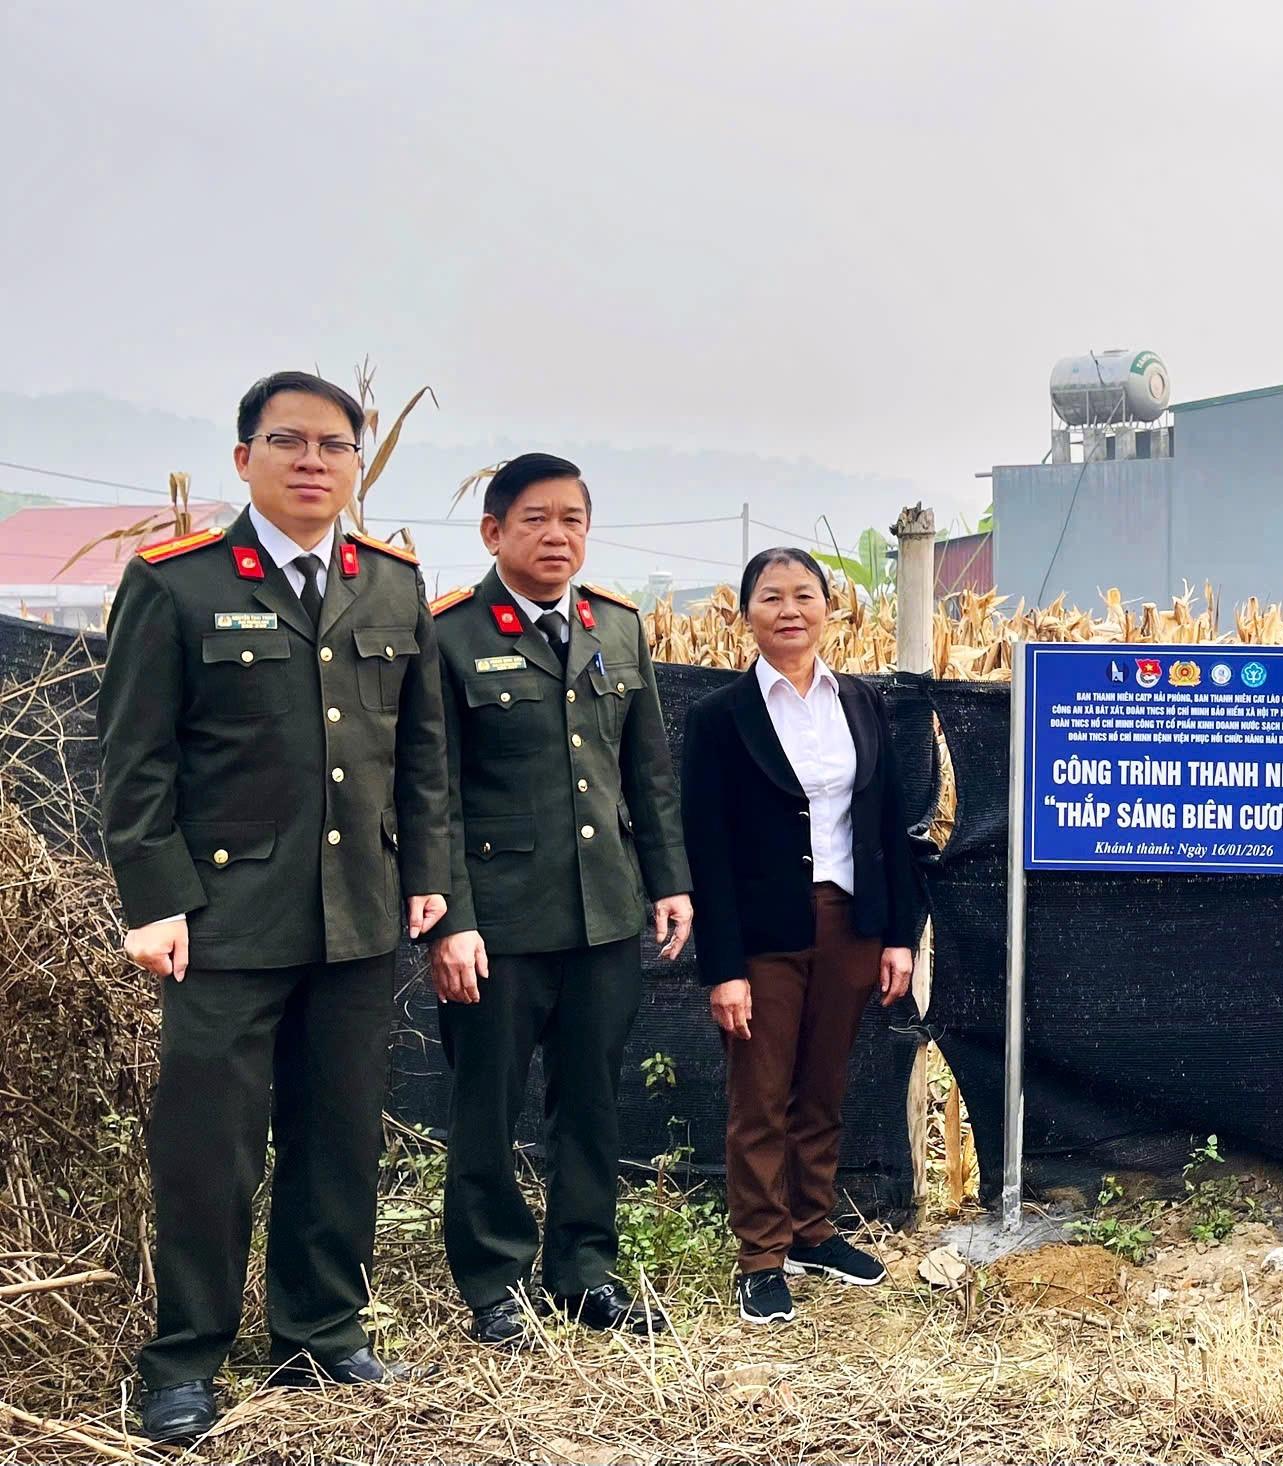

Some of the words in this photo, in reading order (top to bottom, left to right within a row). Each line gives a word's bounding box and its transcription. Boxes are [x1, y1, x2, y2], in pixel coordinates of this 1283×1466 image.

[1076, 692, 1091, 701] BAN
[1093, 692, 1116, 701] THANH
[1117, 691, 1134, 702] NIÊN
[1135, 693, 1152, 702] CATP
[1153, 691, 1165, 702] HẢI
[1194, 694, 1209, 703] BAN
[1210, 694, 1233, 703] THANH
[1234, 693, 1251, 704] NIÊN
[1253, 695, 1265, 704] CAT
[1267, 693, 1280, 704] LÀO
[1052, 704, 1071, 714] CÔNG
[1072, 706, 1083, 714] AN
[1126, 705, 1145, 715] ĐOÀN
[1146, 706, 1164, 715] TNCS
[1177, 705, 1189, 716] CHÍ
[1190, 707, 1209, 716] MINH
[1211, 705, 1225, 716] BẢO
[1257, 707, 1268, 718] HỘI
[1270, 708, 1279, 717] TP
[1050, 718, 1069, 728] ĐOÀN
[1071, 719, 1089, 728] TNCS
[1102, 718, 1114, 728] CHÍ
[1115, 719, 1134, 729] MINH
[1135, 718, 1154, 729] CÔNG
[1155, 720, 1164, 729] TY
[1197, 720, 1214, 730] KINH
[1216, 721, 1239, 730] DOANH
[1261, 721, 1280, 732] SẠCH
[1068, 731, 1087, 741] ĐOÀN
[1089, 732, 1107, 741] TNCS
[1119, 731, 1132, 742] CHÍ
[1133, 733, 1151, 742] MINH
[1153, 732, 1172, 744] BỆNH
[1173, 732, 1189, 744] VIỆN
[1190, 733, 1209, 744] PHỤC
[1265, 732, 1277, 744] HẢI
[1053, 754, 1112, 785] CÔNG
[1117, 755, 1181, 786] TRÌNH
[1187, 761, 1259, 787] THANH
[1044, 793, 1111, 828] “THẮP
[1116, 797, 1176, 828] SÁNG
[1182, 799, 1233, 829] BIÊN
[1094, 841, 1133, 854] Khánh
[1136, 842, 1175, 855] thành:
[1177, 843, 1208, 858] Ngày
[1211, 844, 1274, 857] 16/01/2026
